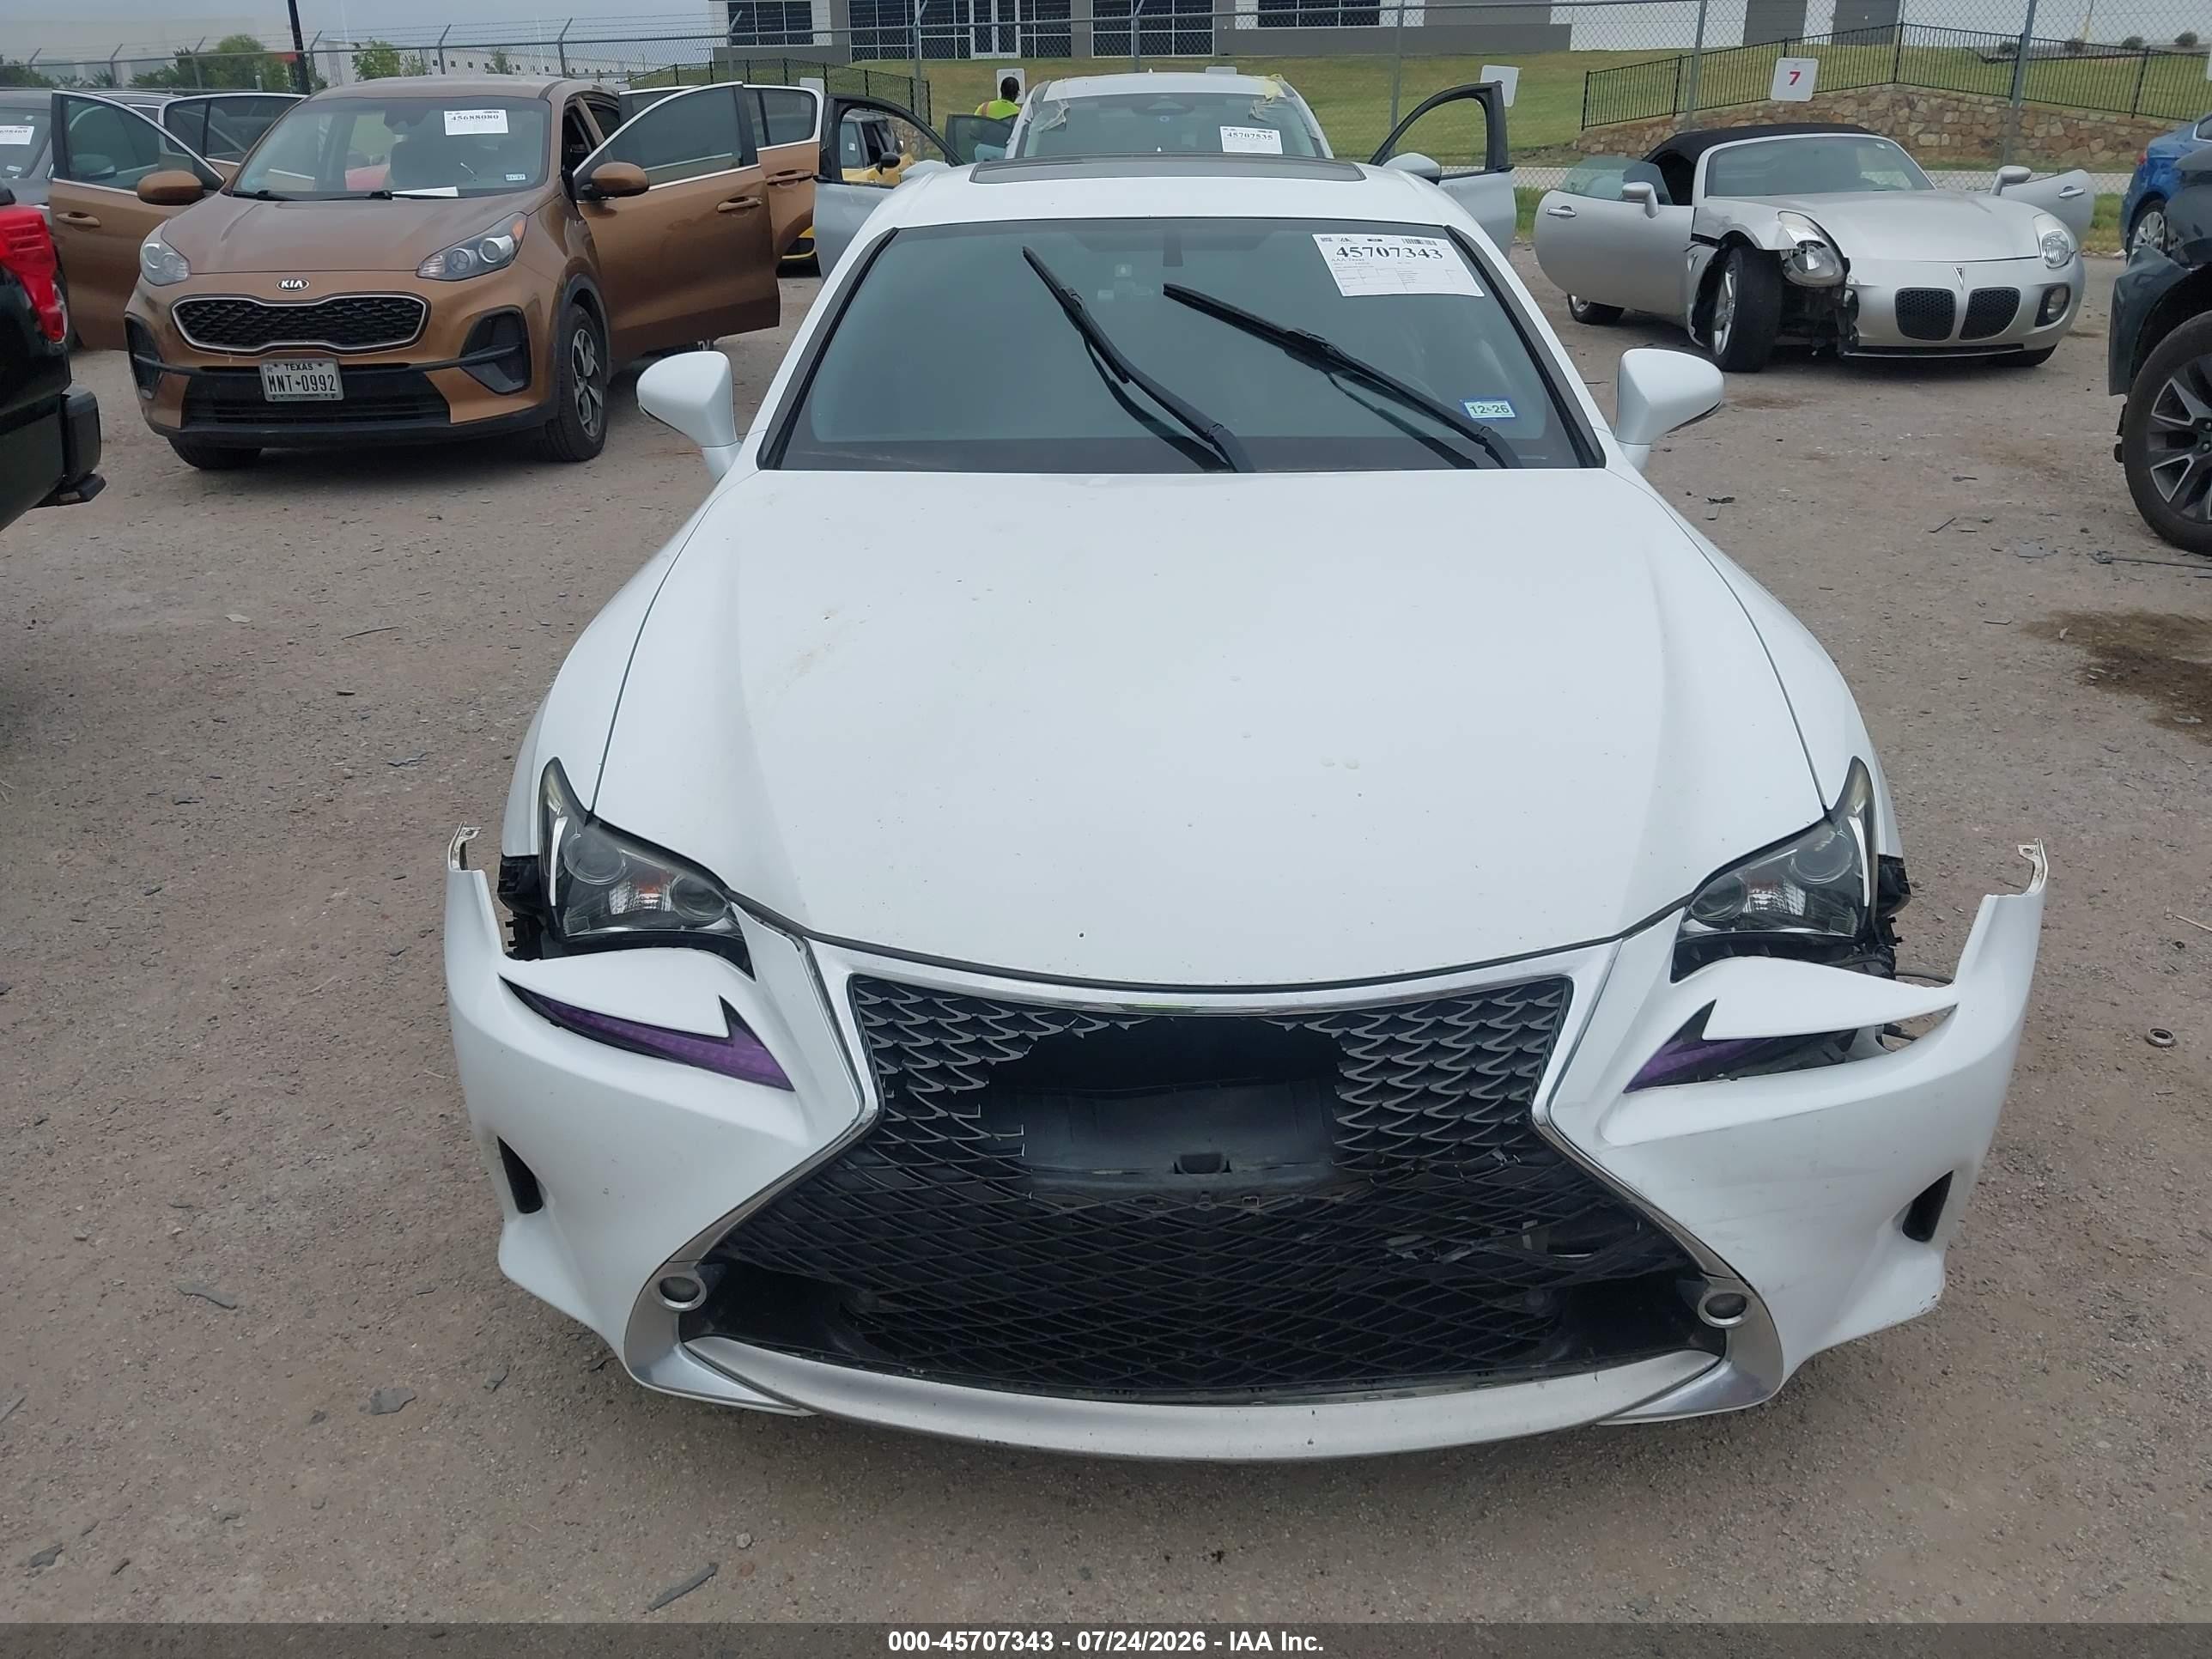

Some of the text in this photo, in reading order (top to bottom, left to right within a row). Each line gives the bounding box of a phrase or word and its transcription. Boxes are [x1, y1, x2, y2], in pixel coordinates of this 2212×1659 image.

[1789, 71, 1801, 86] 7
[1336, 246, 1443, 259] 45707343
[281, 280, 303, 289] KIA
